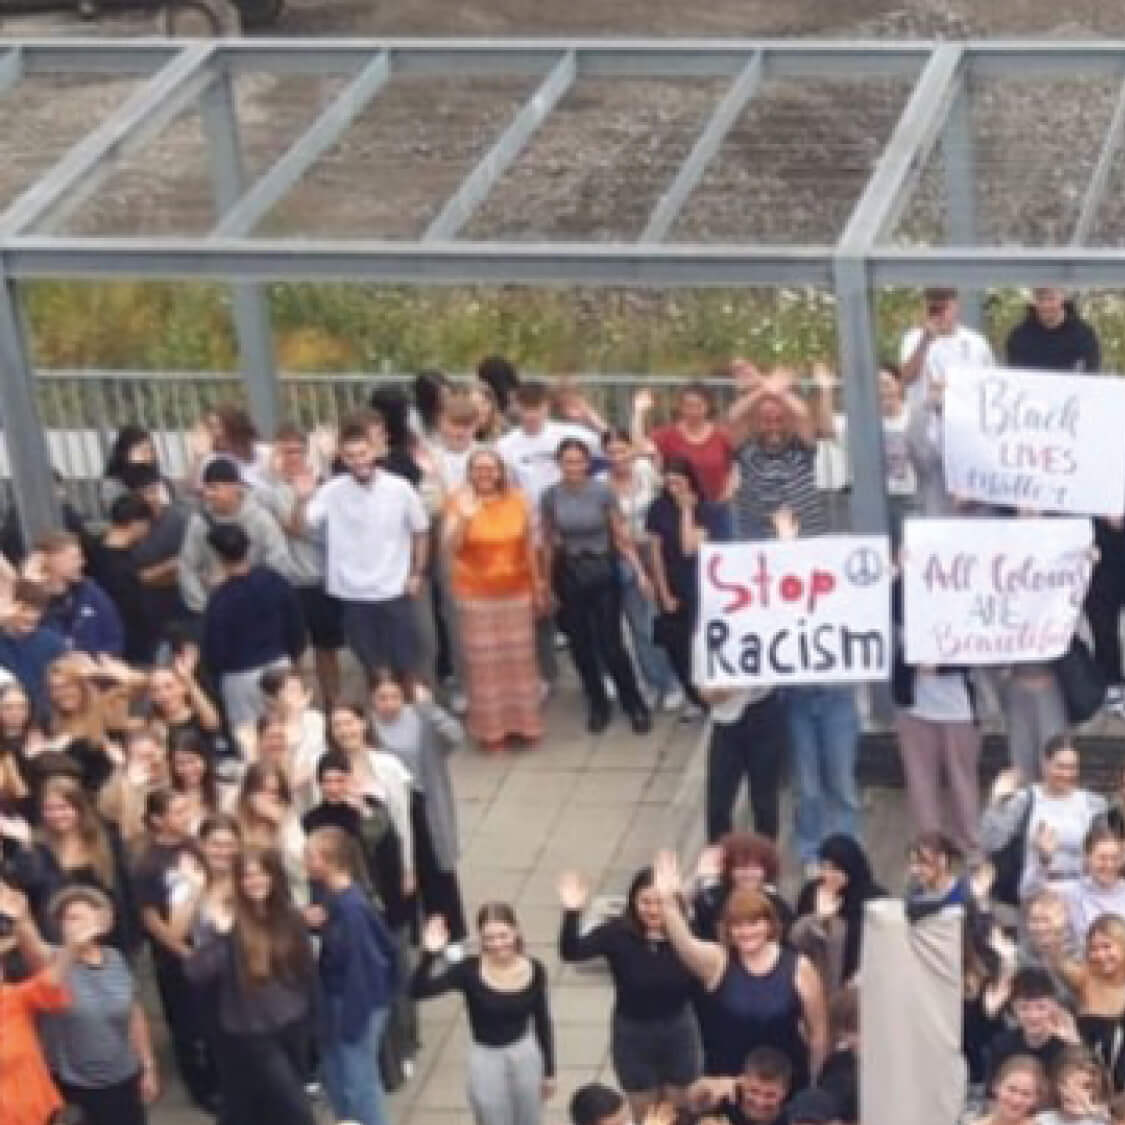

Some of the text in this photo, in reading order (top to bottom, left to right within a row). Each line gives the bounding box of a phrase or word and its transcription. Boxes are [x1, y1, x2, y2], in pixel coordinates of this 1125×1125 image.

[1000, 441, 1078, 474] LIVES
[706, 550, 836, 614] Stop
[706, 617, 884, 679] Racism
